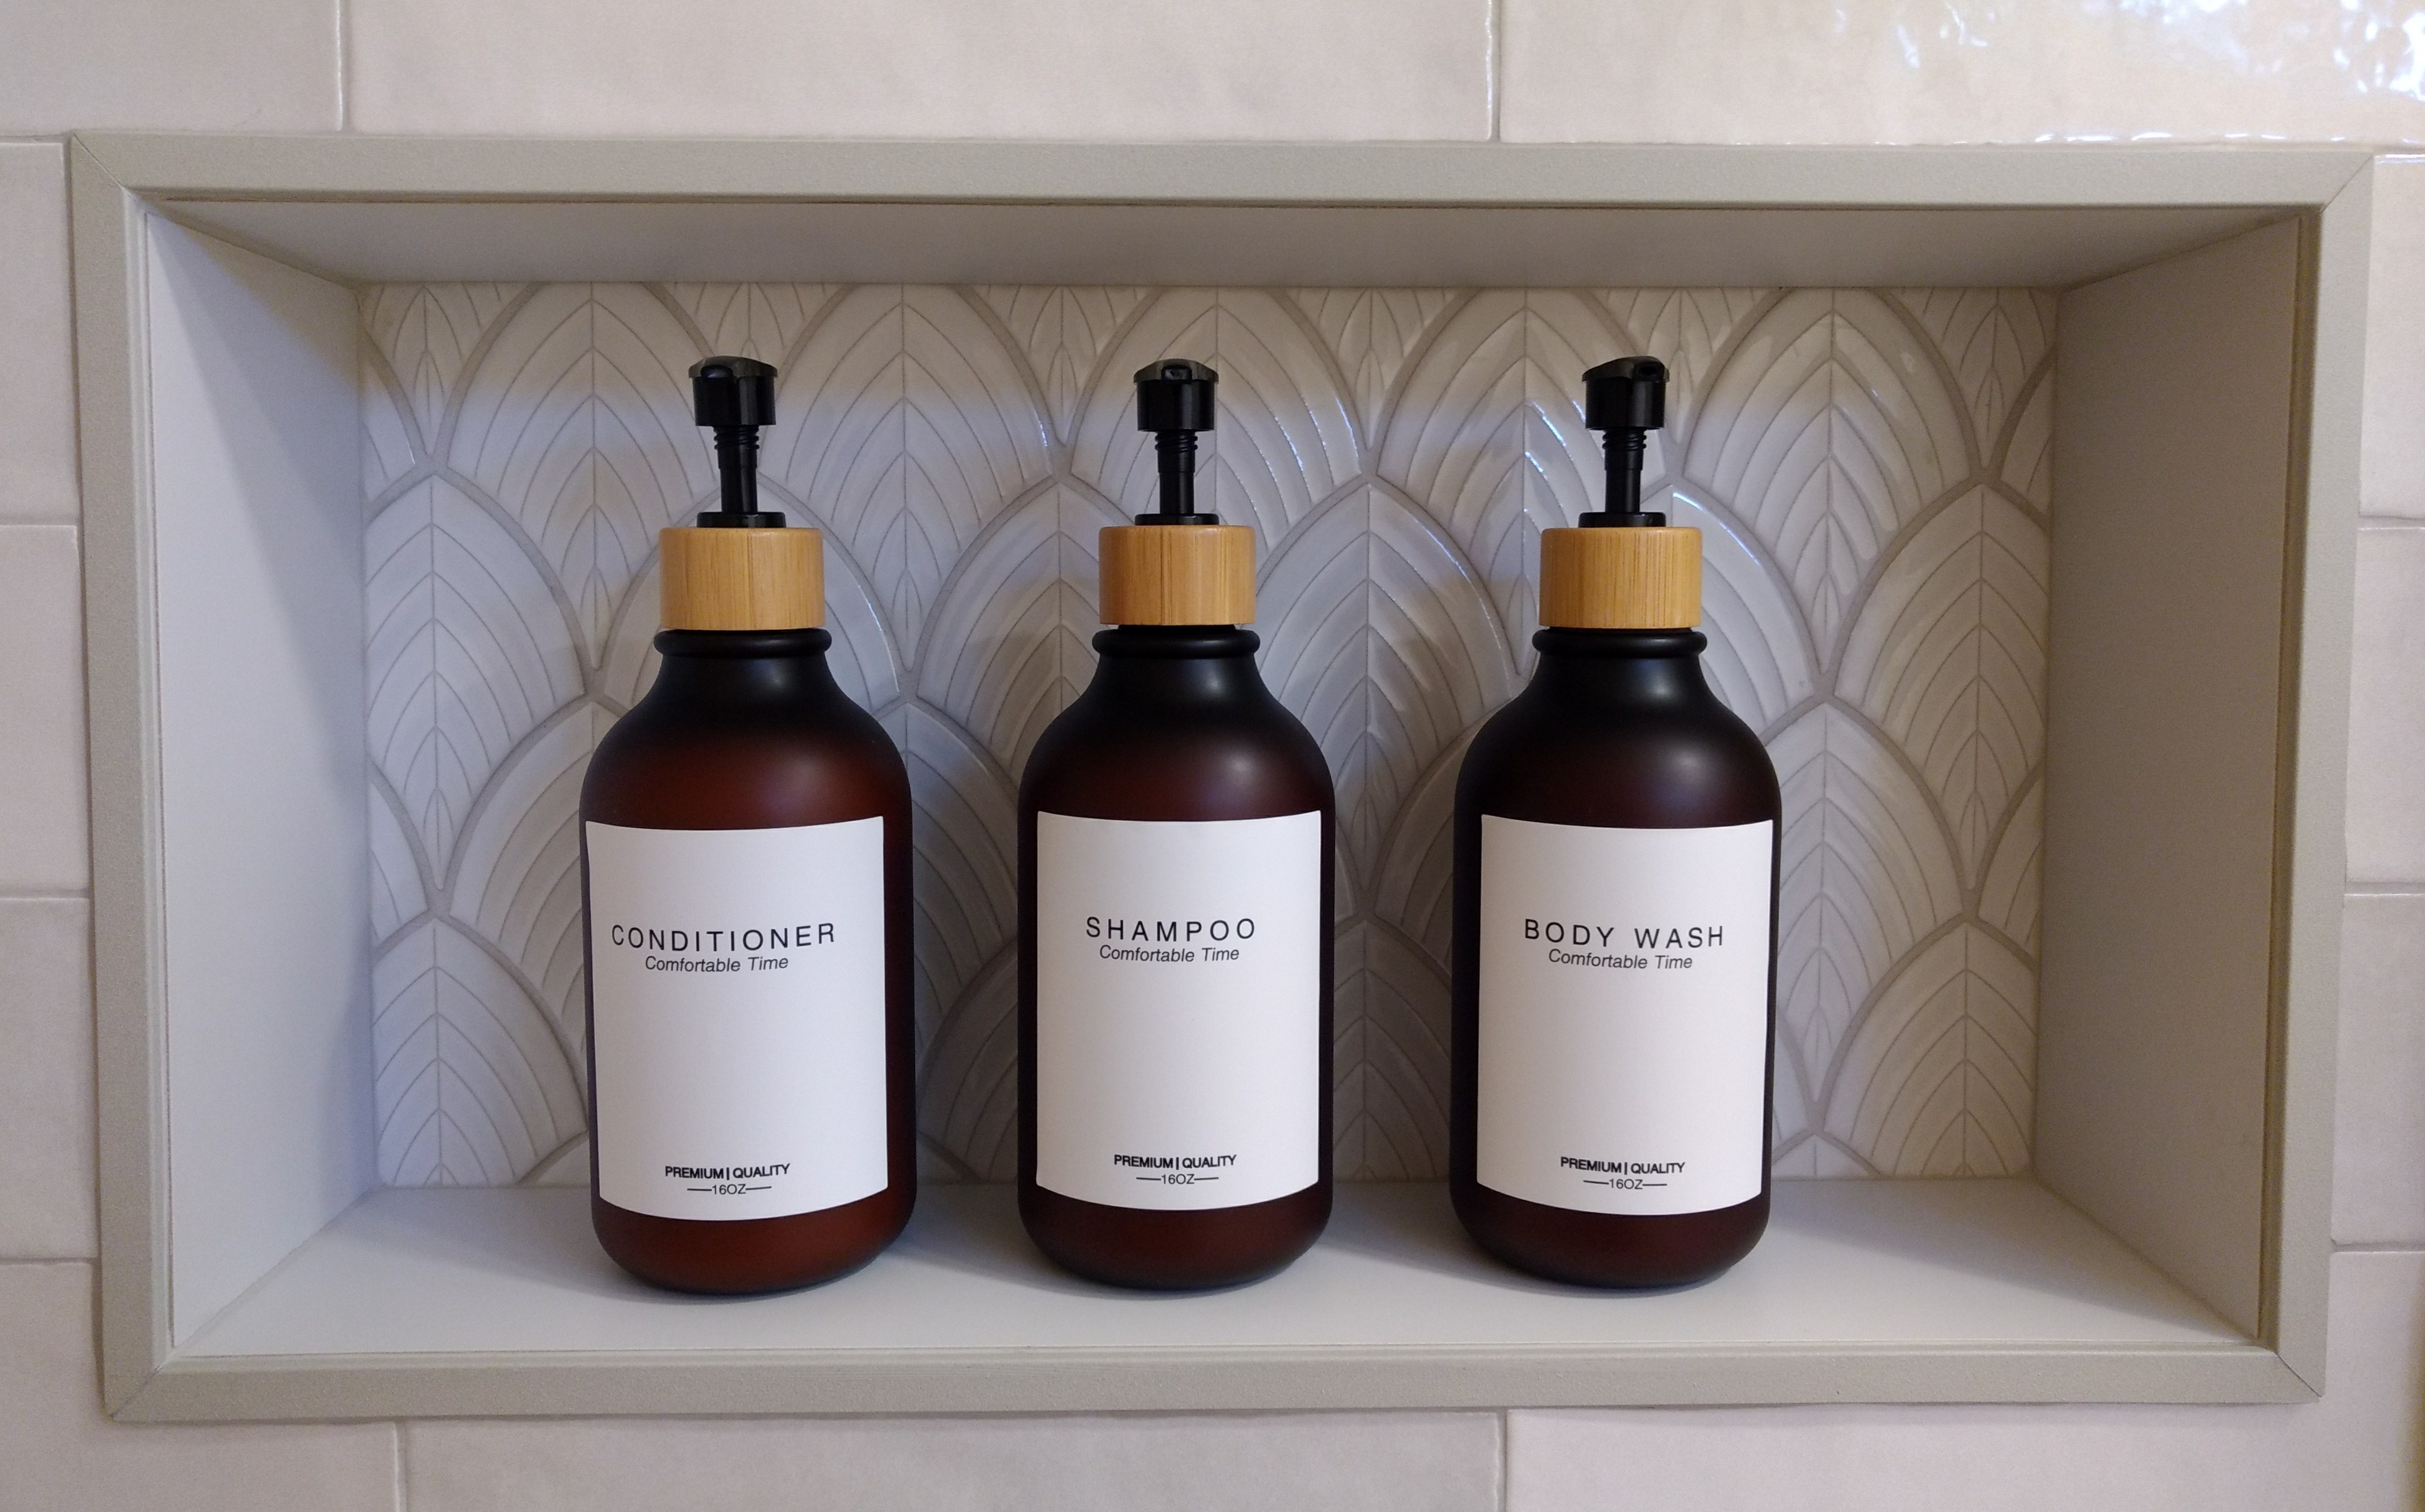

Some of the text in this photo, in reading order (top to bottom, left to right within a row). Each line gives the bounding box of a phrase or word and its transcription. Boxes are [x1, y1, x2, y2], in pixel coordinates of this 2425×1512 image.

[612, 923, 835, 952] CONDITIONER
[1085, 916, 1255, 943] SHAMPOO
[1524, 918, 1723, 949] BODY WASH
[645, 956, 789, 972] Comfortable Time
[1099, 944, 1240, 963] Comfortable Time
[1548, 948, 1693, 970] Comfortable Time
